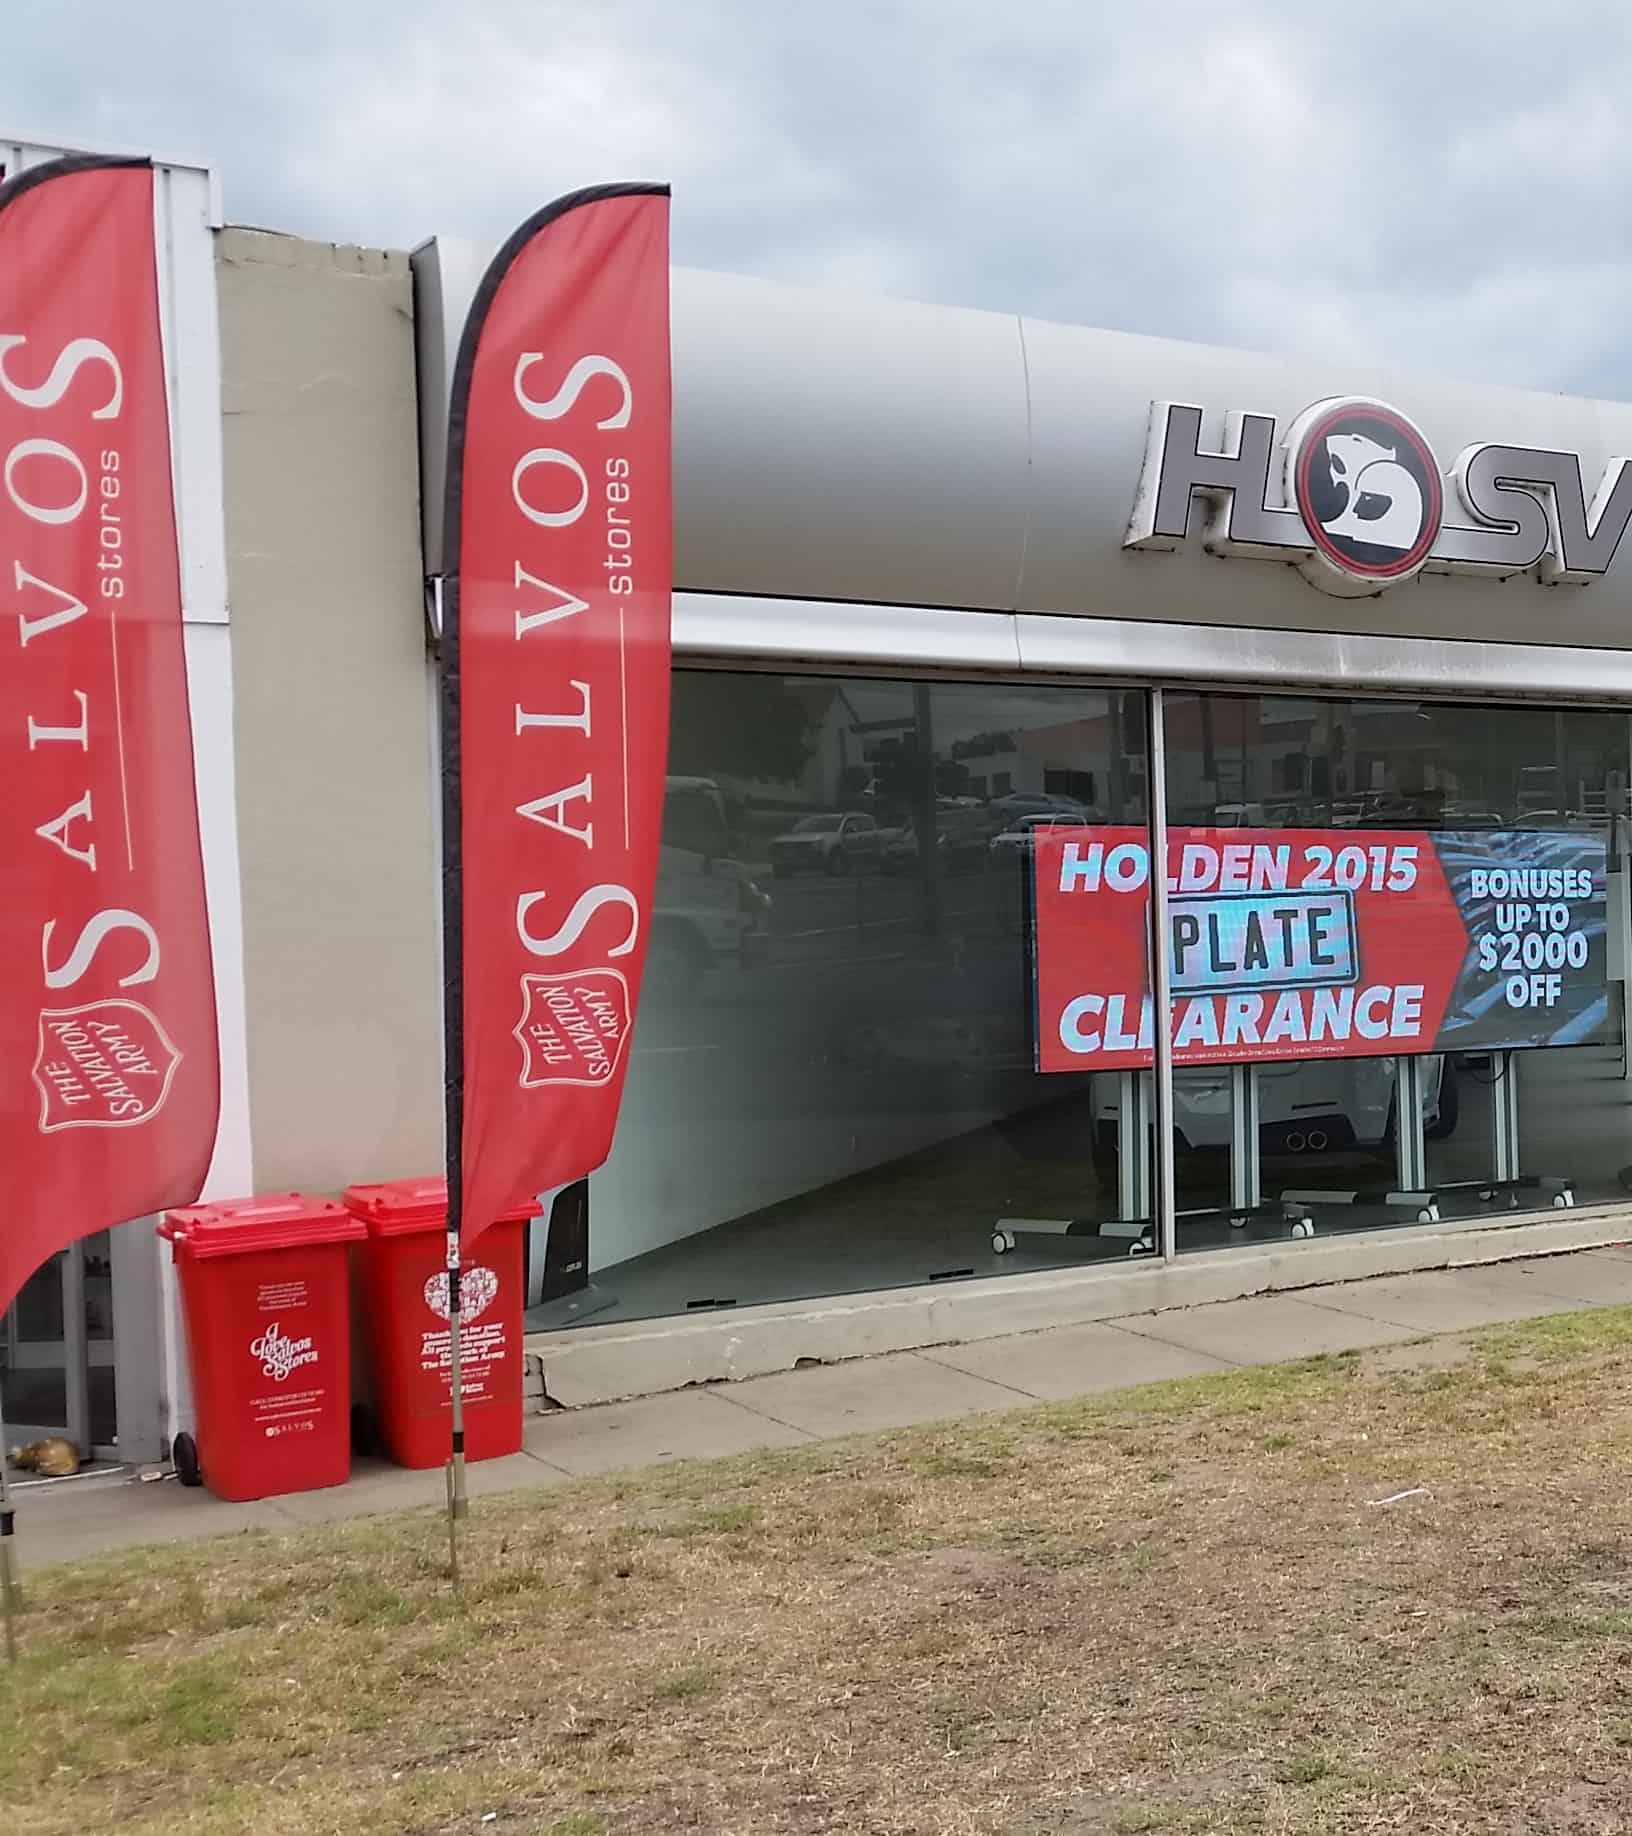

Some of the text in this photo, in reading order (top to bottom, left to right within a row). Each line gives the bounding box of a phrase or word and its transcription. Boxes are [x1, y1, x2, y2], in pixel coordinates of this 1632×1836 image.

[97, 450, 121, 599] stores
[607, 456, 634, 595] stores
[0, 333, 160, 989] SALVOS
[512, 351, 639, 957] SALVOS
[1301, 845, 1418, 892] 2015
[1470, 869, 1593, 899] BONUSES
[1172, 907, 1335, 975] PLATE
[1496, 902, 1570, 932] UP TO
[1479, 931, 1588, 971] $2000
[574, 987, 619, 1039] ARMY
[1505, 973, 1562, 1008] OFF
[87, 1021, 158, 1074] ARMY
[529, 1023, 573, 1065] THE
[536, 986, 611, 1075] SALVATION
[45, 1061, 91, 1105] THE
[48, 1020, 144, 1115] SALVATION
